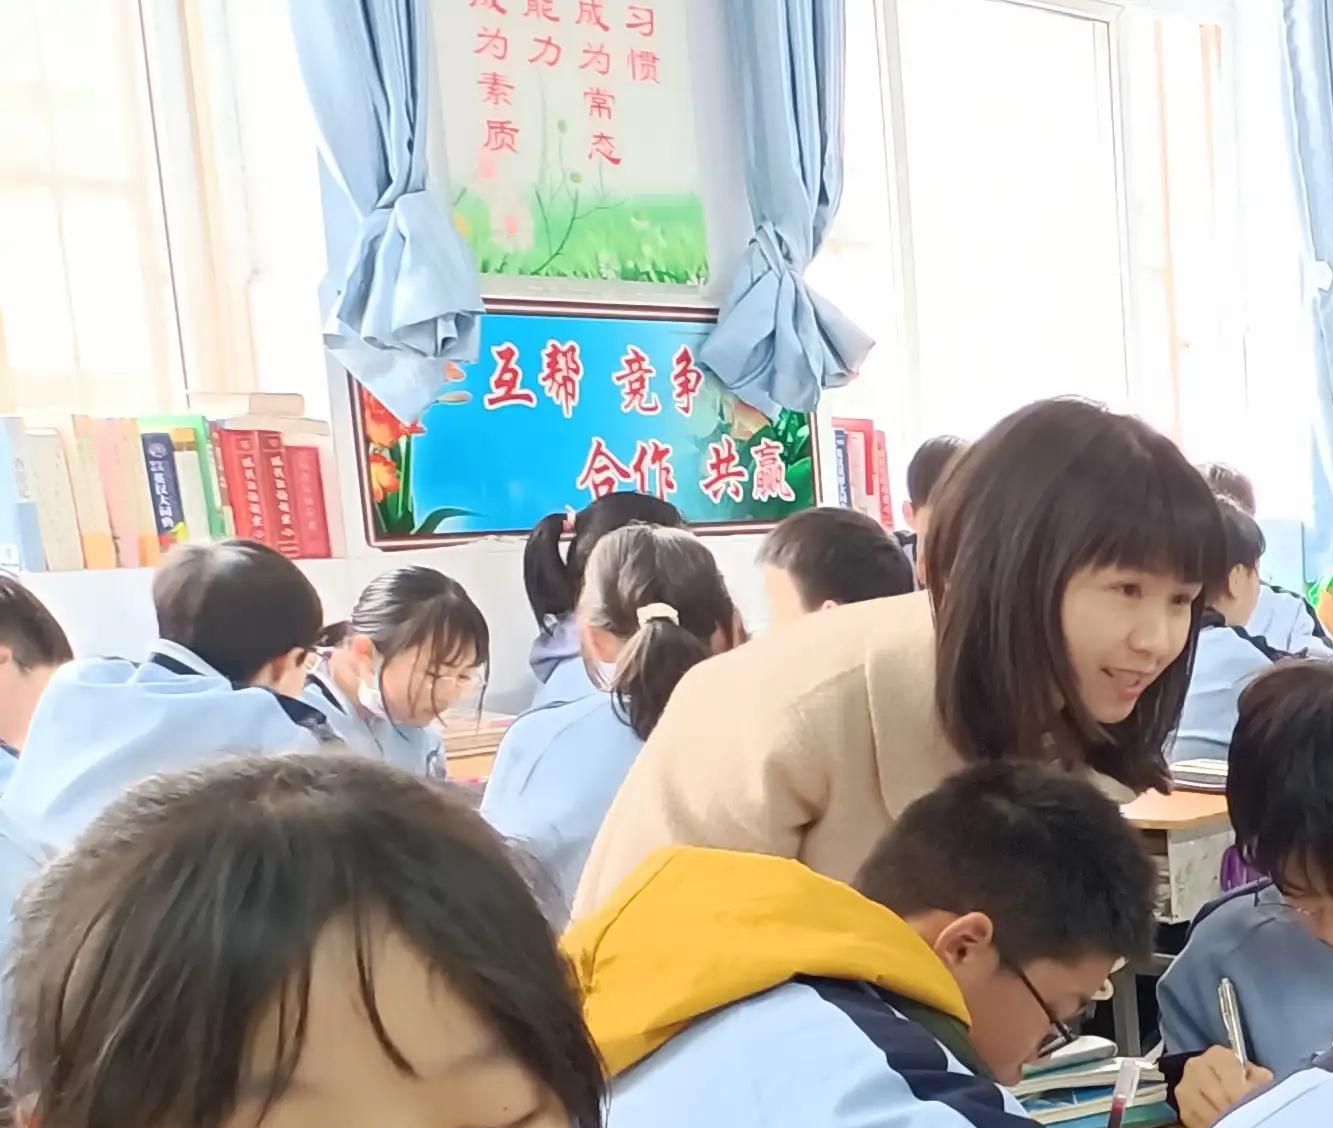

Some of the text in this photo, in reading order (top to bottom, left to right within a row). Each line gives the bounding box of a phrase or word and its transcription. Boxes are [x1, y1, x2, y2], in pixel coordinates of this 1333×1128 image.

[484, 338, 703, 417] 互帮 竞争
[577, 436, 677, 500] 合作
[700, 434, 796, 504] 共赢
